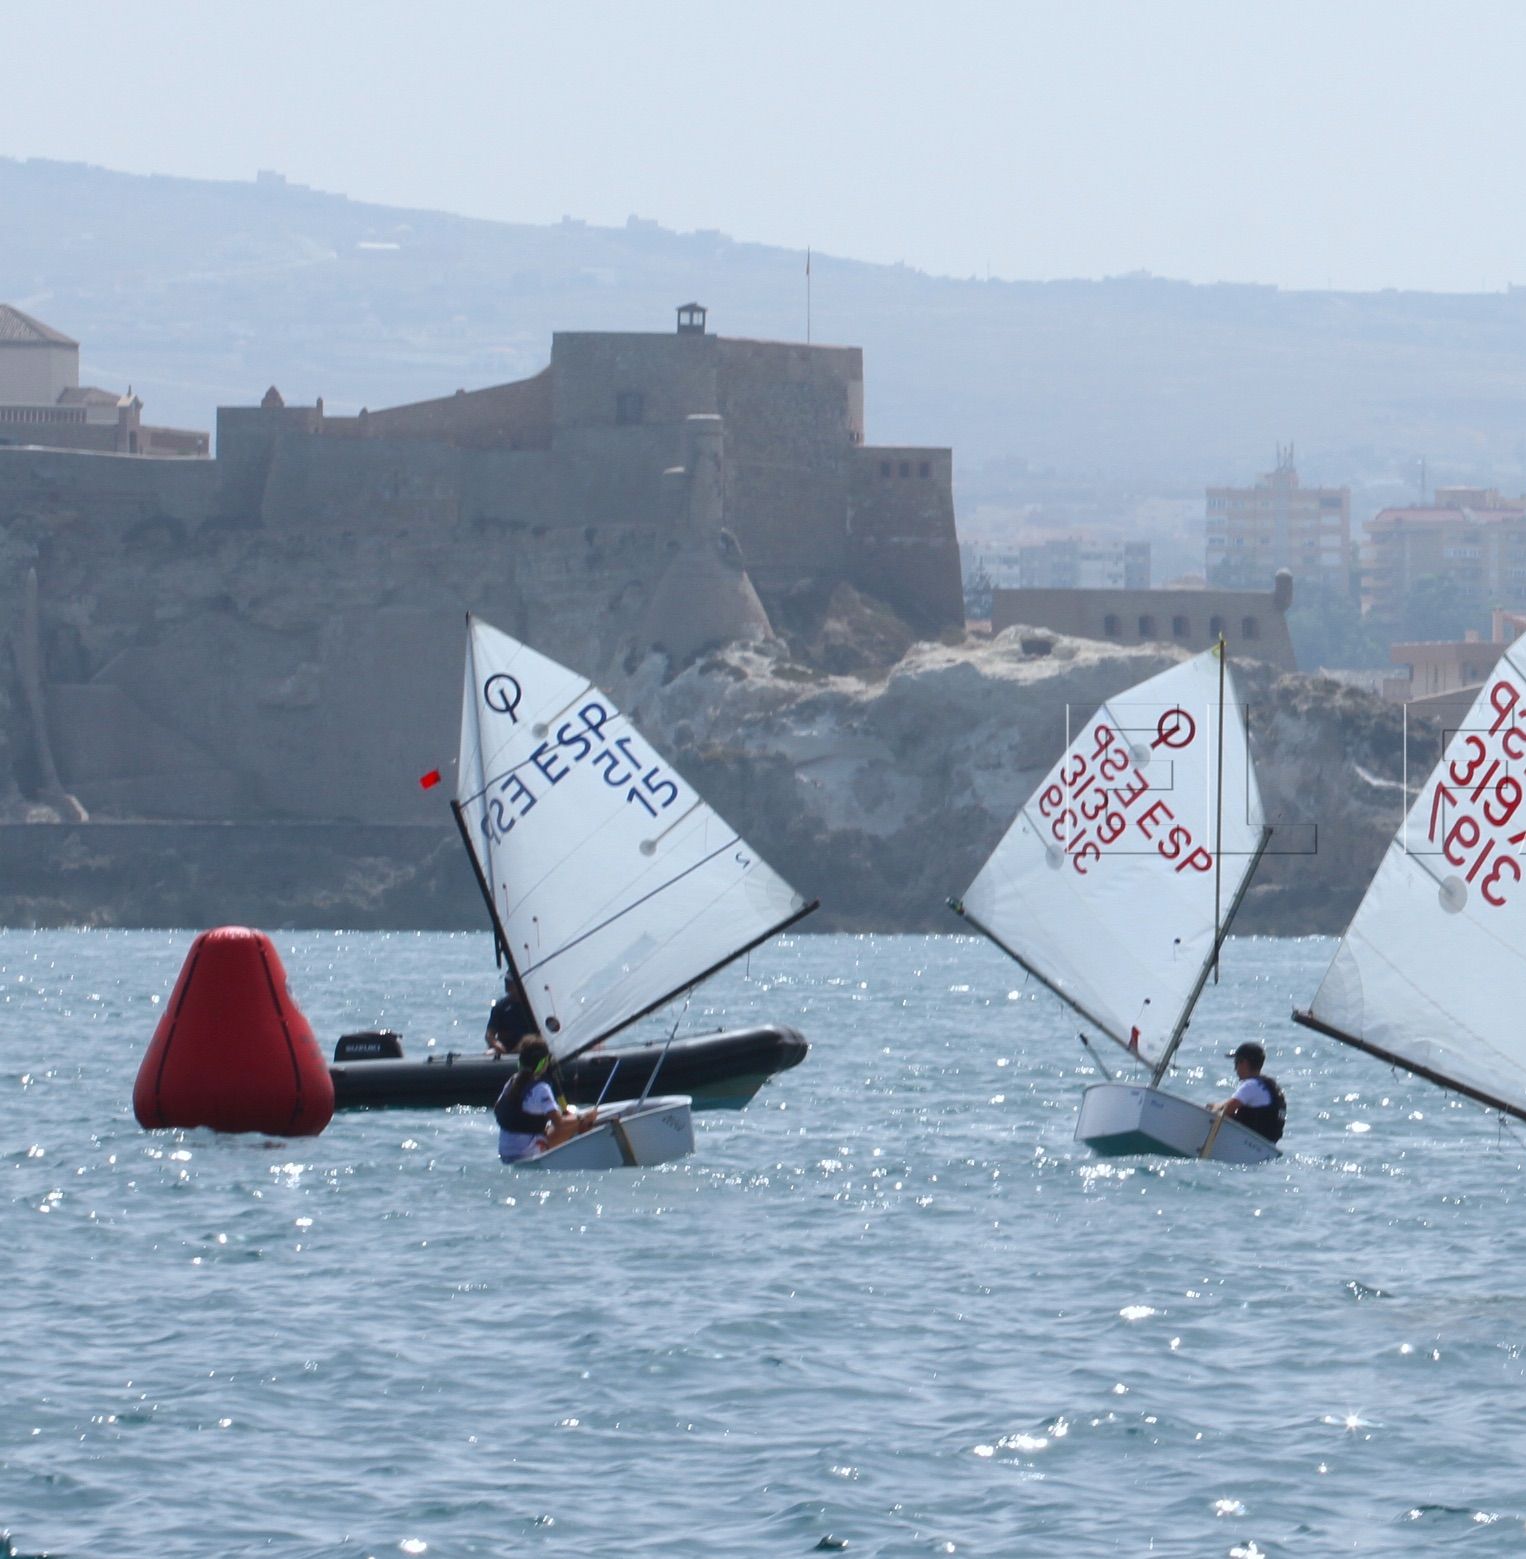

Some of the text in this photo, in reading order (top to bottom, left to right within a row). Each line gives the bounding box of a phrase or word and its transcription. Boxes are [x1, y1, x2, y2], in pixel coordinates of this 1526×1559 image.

[529, 702, 608, 786] ESP
[626, 766, 679, 818] 15
[1058, 754, 1128, 845] 3139
[1136, 800, 1213, 874] ESP
